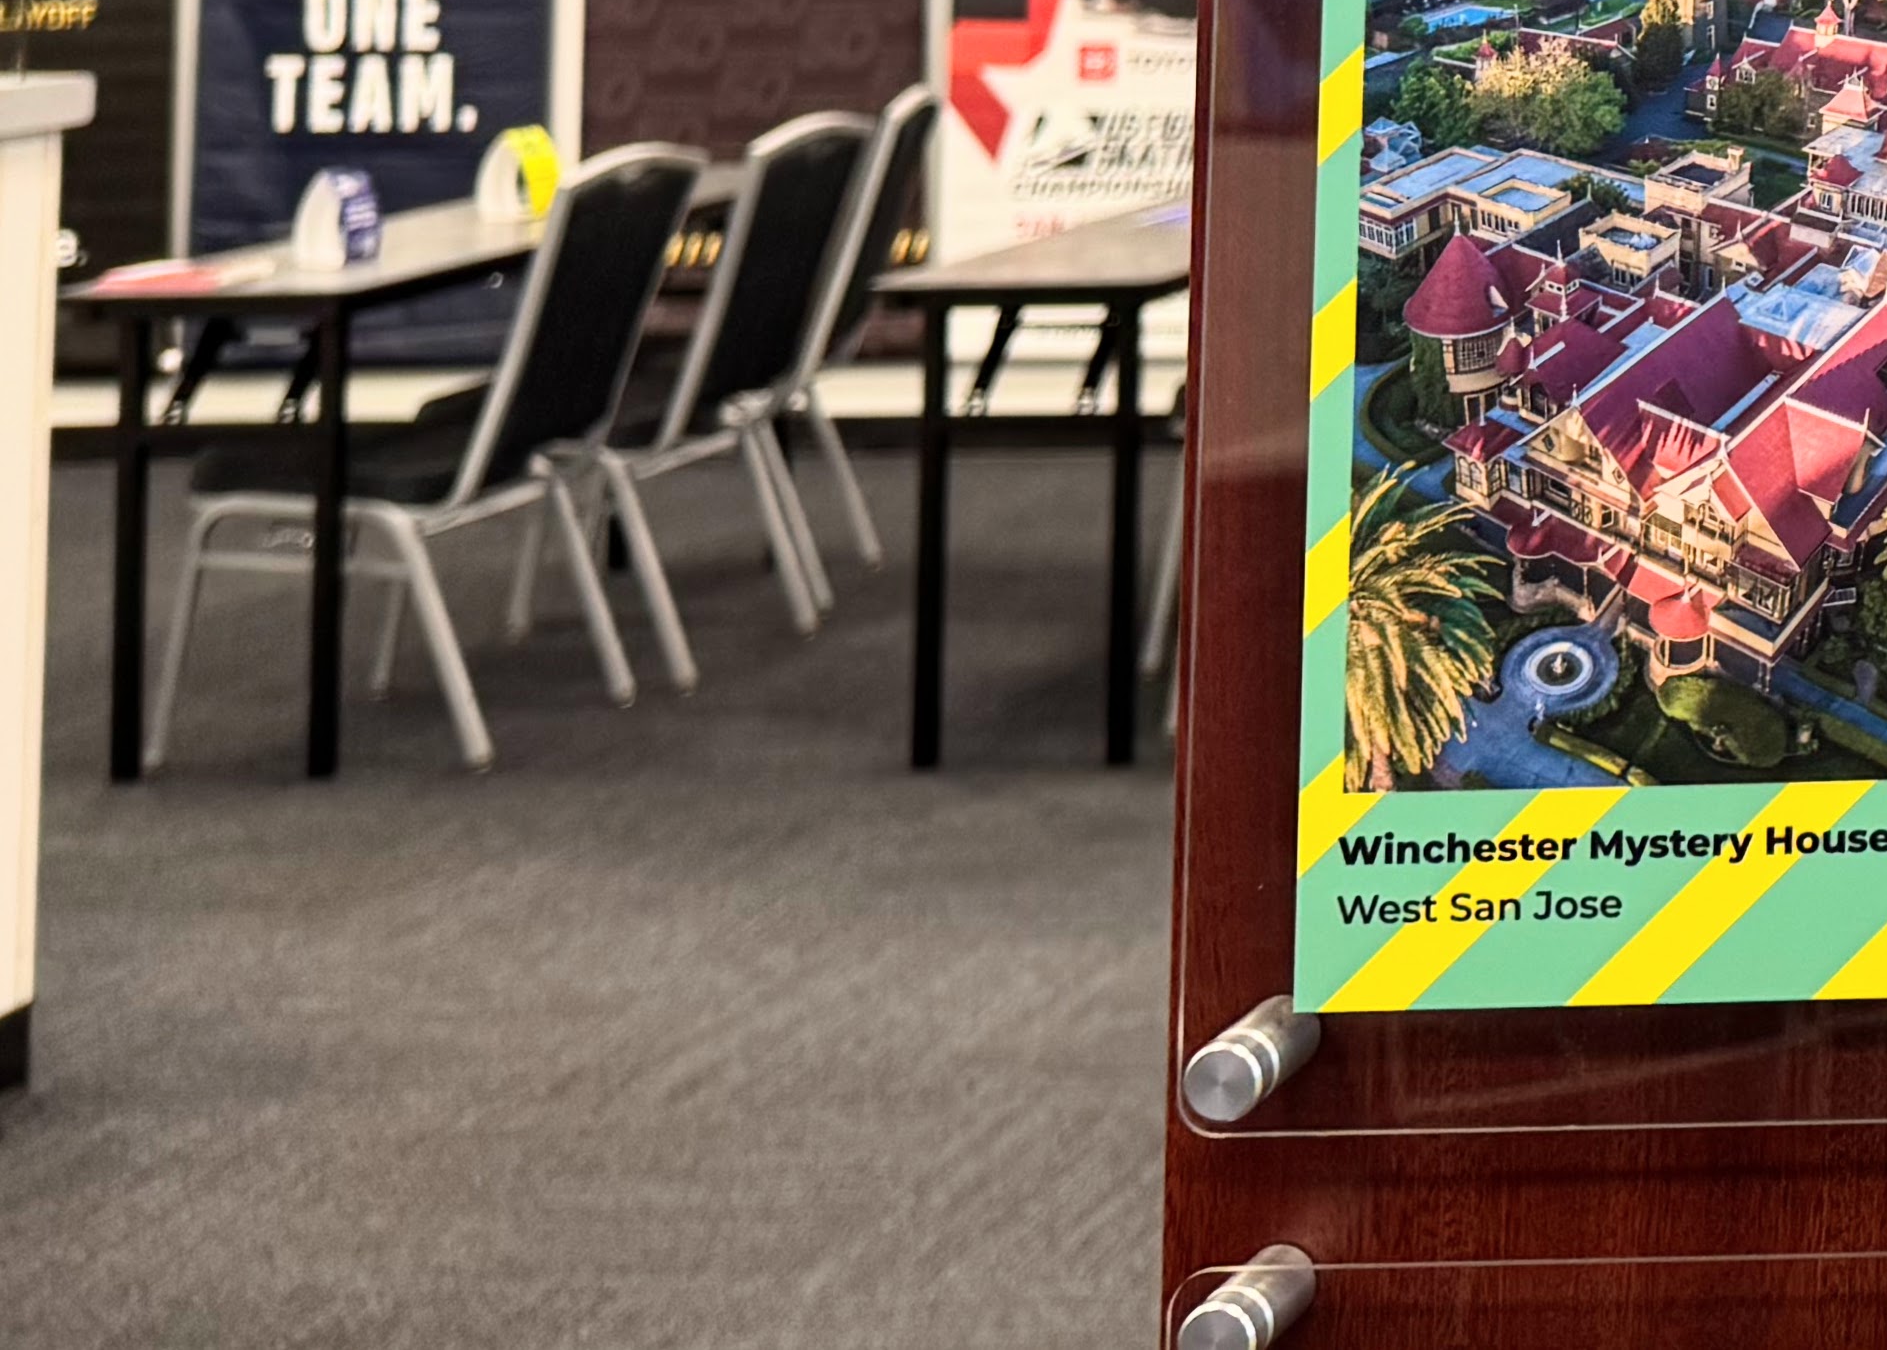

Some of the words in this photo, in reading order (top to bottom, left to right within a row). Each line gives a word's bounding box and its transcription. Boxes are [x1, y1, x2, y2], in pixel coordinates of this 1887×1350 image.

[265, 54, 476, 135] TEAM.
[1337, 833, 1577, 866] Winchester
[1589, 829, 1750, 866] Mystery
[1337, 894, 1438, 925] West
[1449, 892, 1522, 923] San
[1533, 890, 1623, 921] Jose
